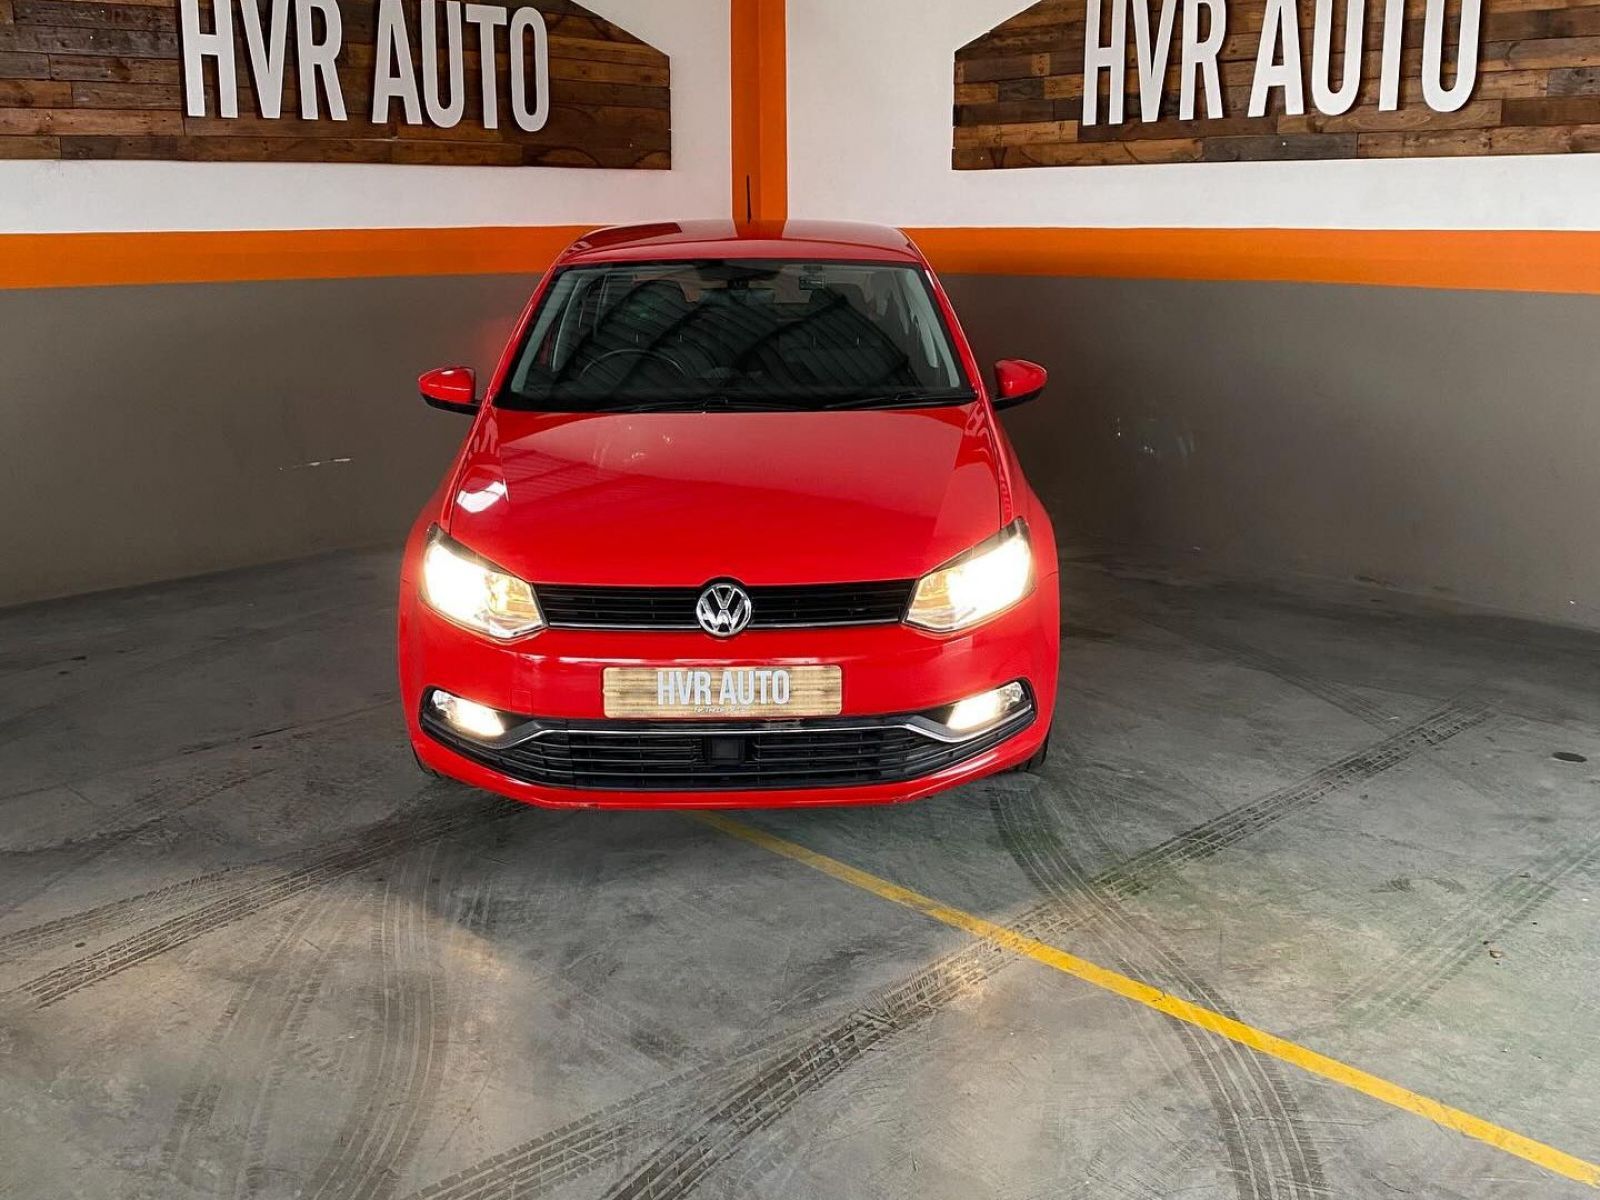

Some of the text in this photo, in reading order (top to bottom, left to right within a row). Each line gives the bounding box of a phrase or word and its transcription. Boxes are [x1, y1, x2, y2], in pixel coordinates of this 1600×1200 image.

[180, 0, 549, 132] HVR AUTO
[1082, 0, 1226, 126] HVR
[657, 669, 790, 705] HVR AUTO
